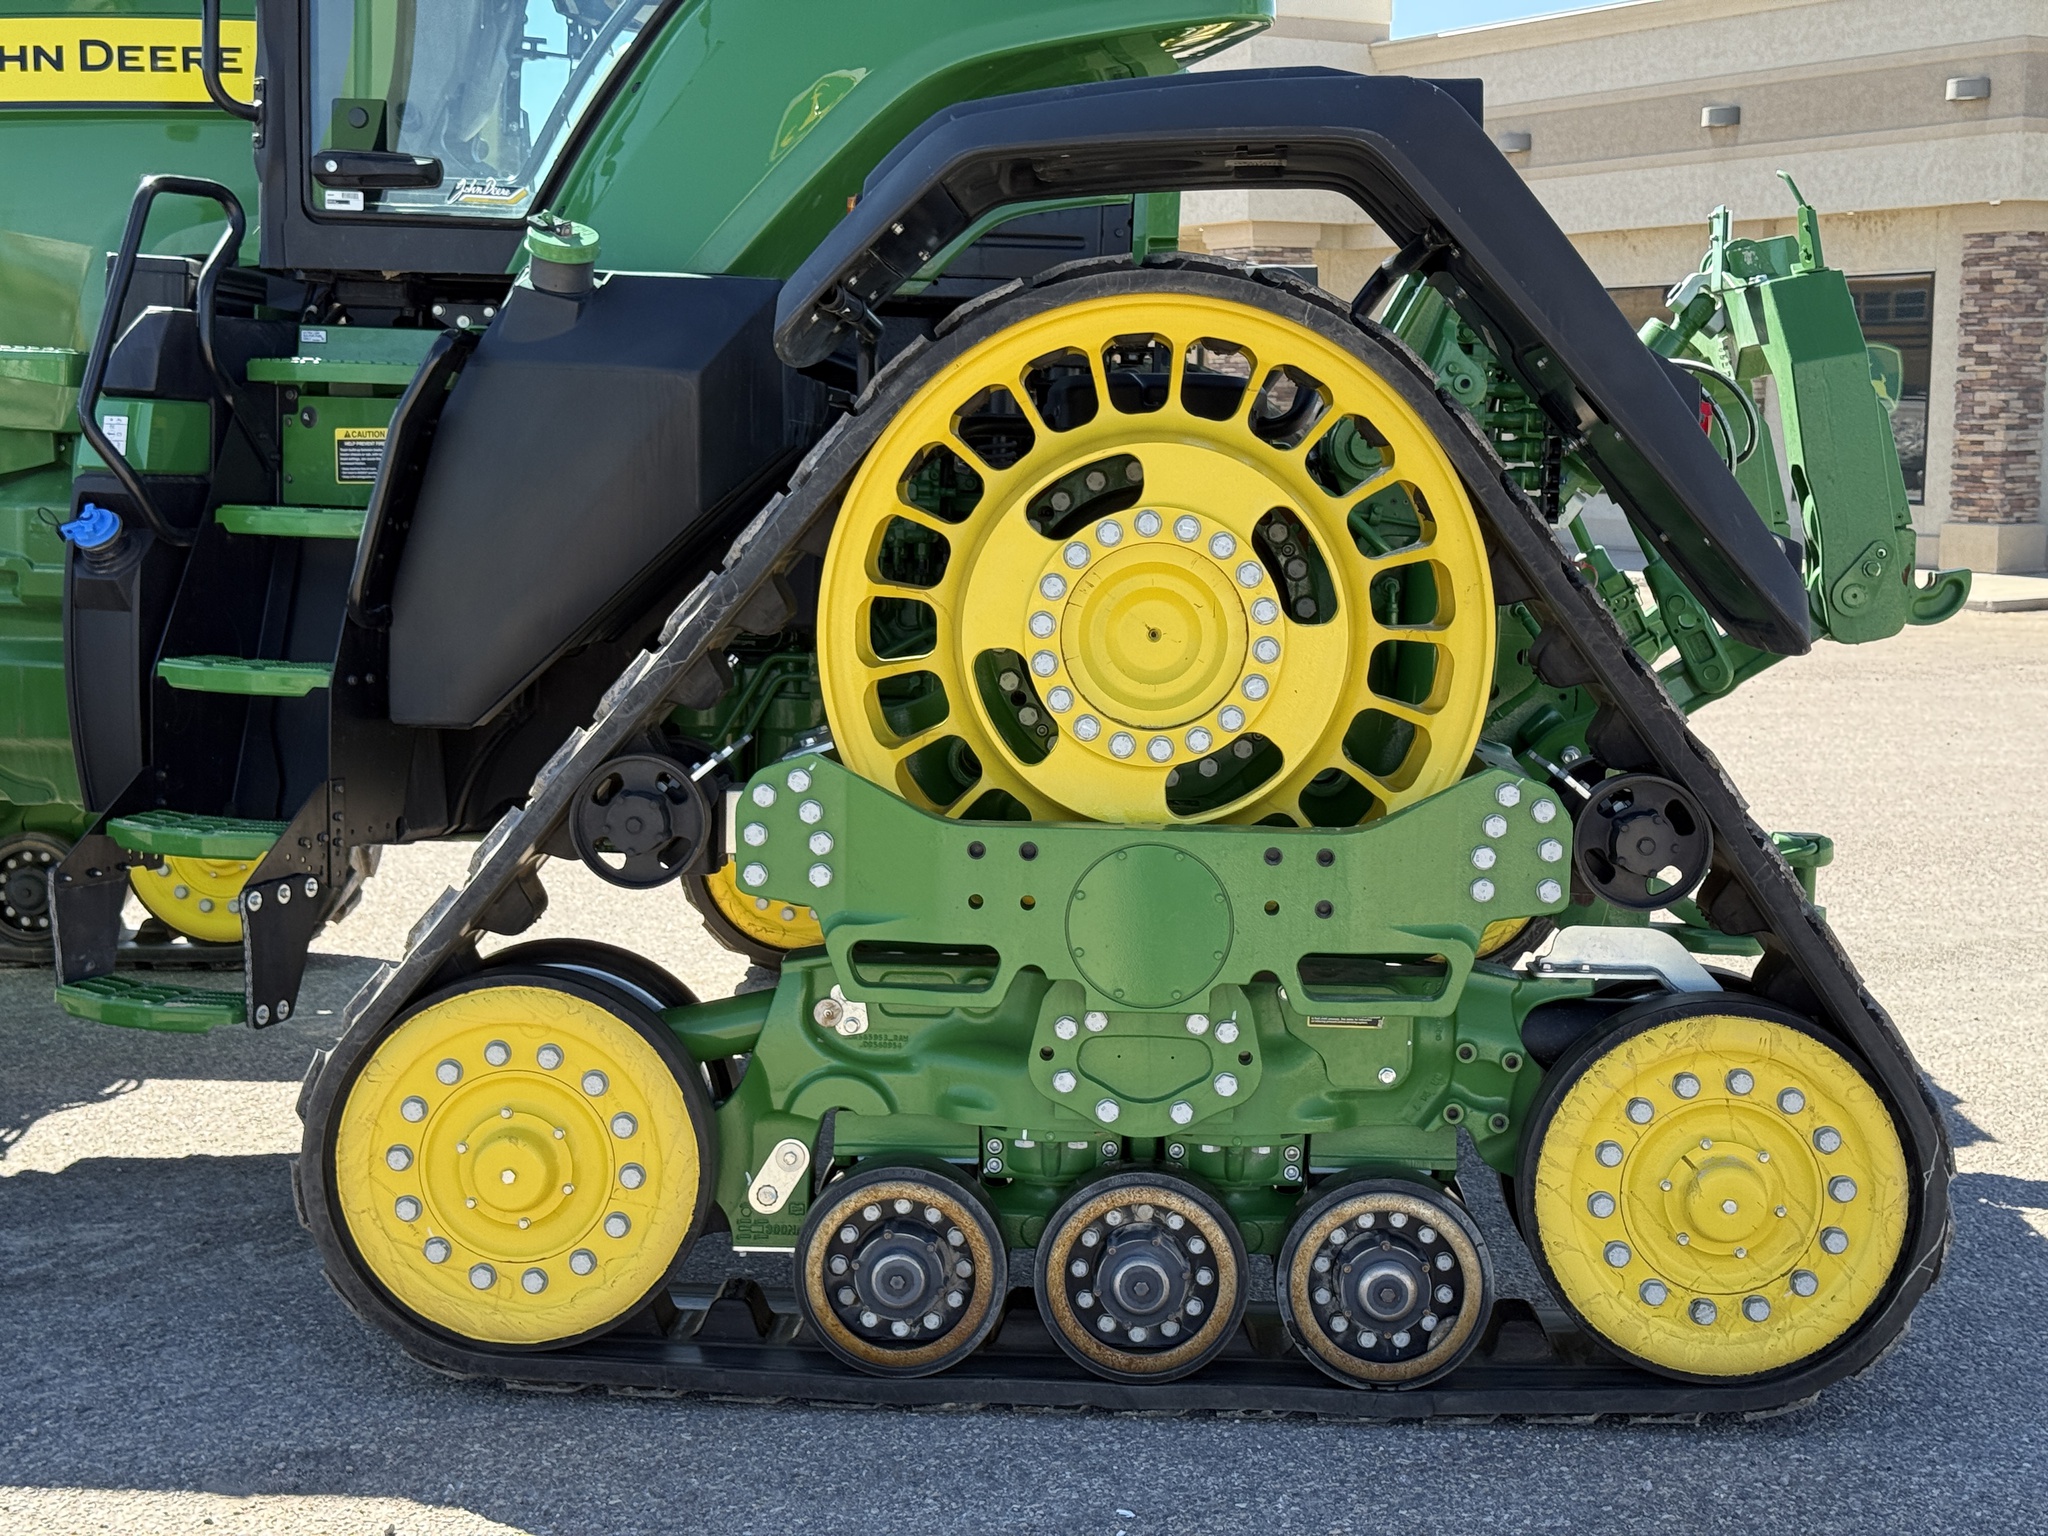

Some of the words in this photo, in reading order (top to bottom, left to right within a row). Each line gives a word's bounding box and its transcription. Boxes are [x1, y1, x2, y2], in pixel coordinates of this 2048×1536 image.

[0, 45, 64, 72] HN
[79, 39, 243, 74] DEERE
[447, 178, 481, 205] John
[483, 176, 512, 196] Deere
[351, 430, 386, 438] CAUTION
